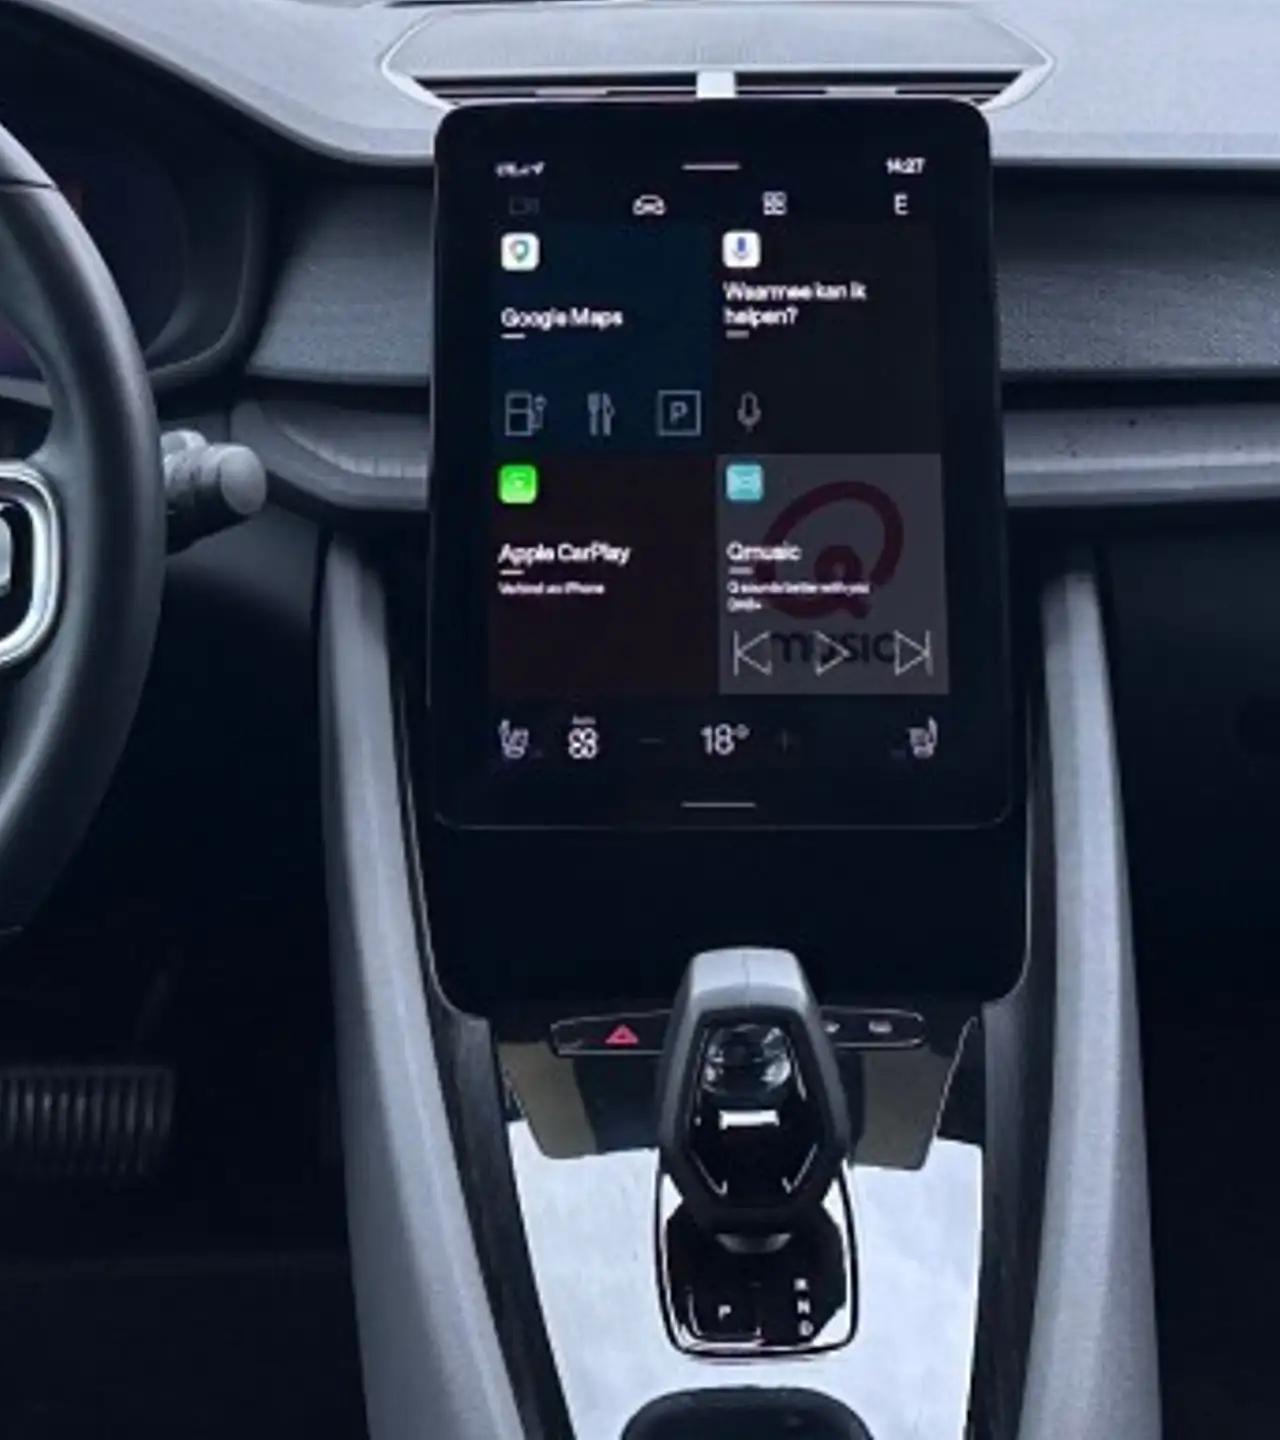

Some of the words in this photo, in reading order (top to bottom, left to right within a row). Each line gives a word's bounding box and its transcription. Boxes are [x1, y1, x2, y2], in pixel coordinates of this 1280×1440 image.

[884, 157, 926, 175] 14:27
[814, 281, 848, 300] kan
[501, 306, 567, 331] Google
[568, 307, 623, 331] Maps
[723, 305, 799, 328] helpen?
[498, 542, 555, 567] Apple
[557, 540, 632, 567] CarPlay
[726, 541, 803, 561] Qmusic
[700, 723, 751, 756] 18°
